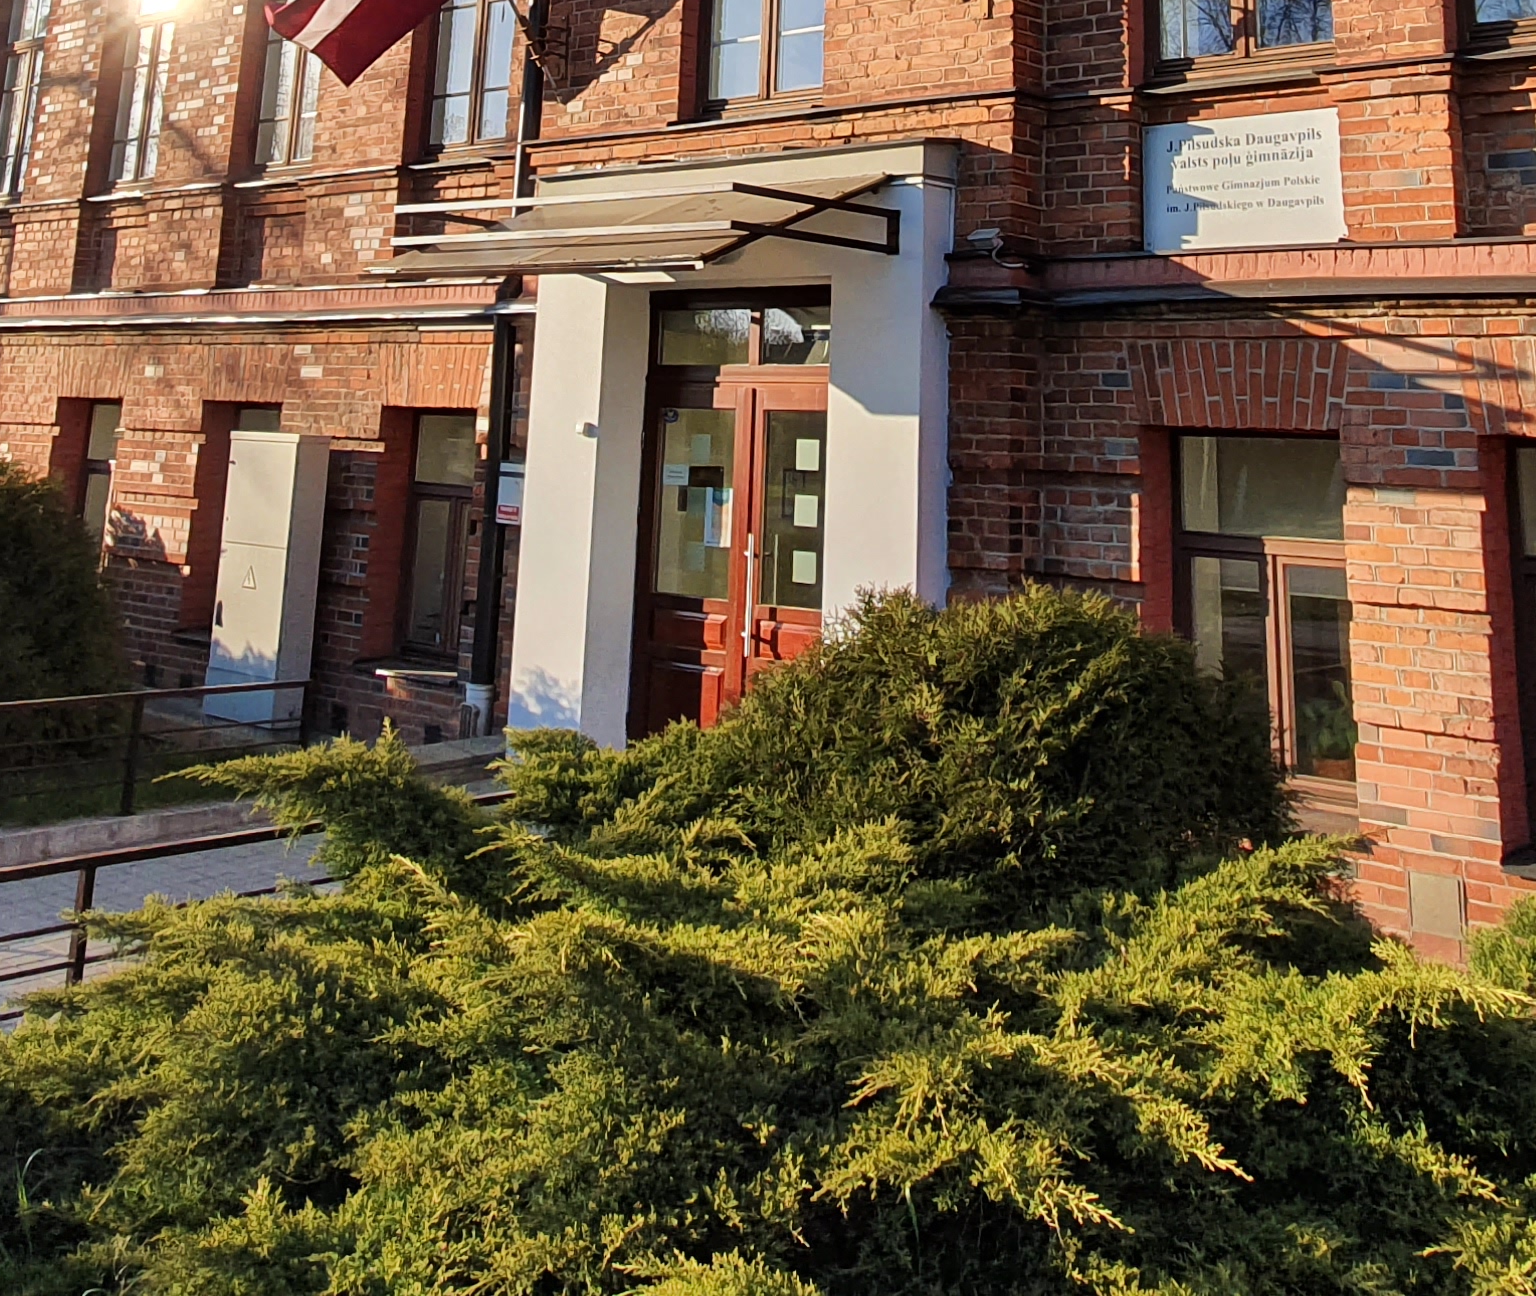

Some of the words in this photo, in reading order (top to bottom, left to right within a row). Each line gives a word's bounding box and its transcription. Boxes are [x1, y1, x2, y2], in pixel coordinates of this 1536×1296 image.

[1245, 127, 1322, 147] Daugavpils
[1171, 155, 1208, 170] valsts
[1246, 146, 1313, 167] ģimnāzija
[1221, 177, 1280, 191] Gimnazjum
[1283, 174, 1321, 187] Polskie
[1256, 201, 1264, 209] w
[1267, 195, 1325, 209] Daugavpils
